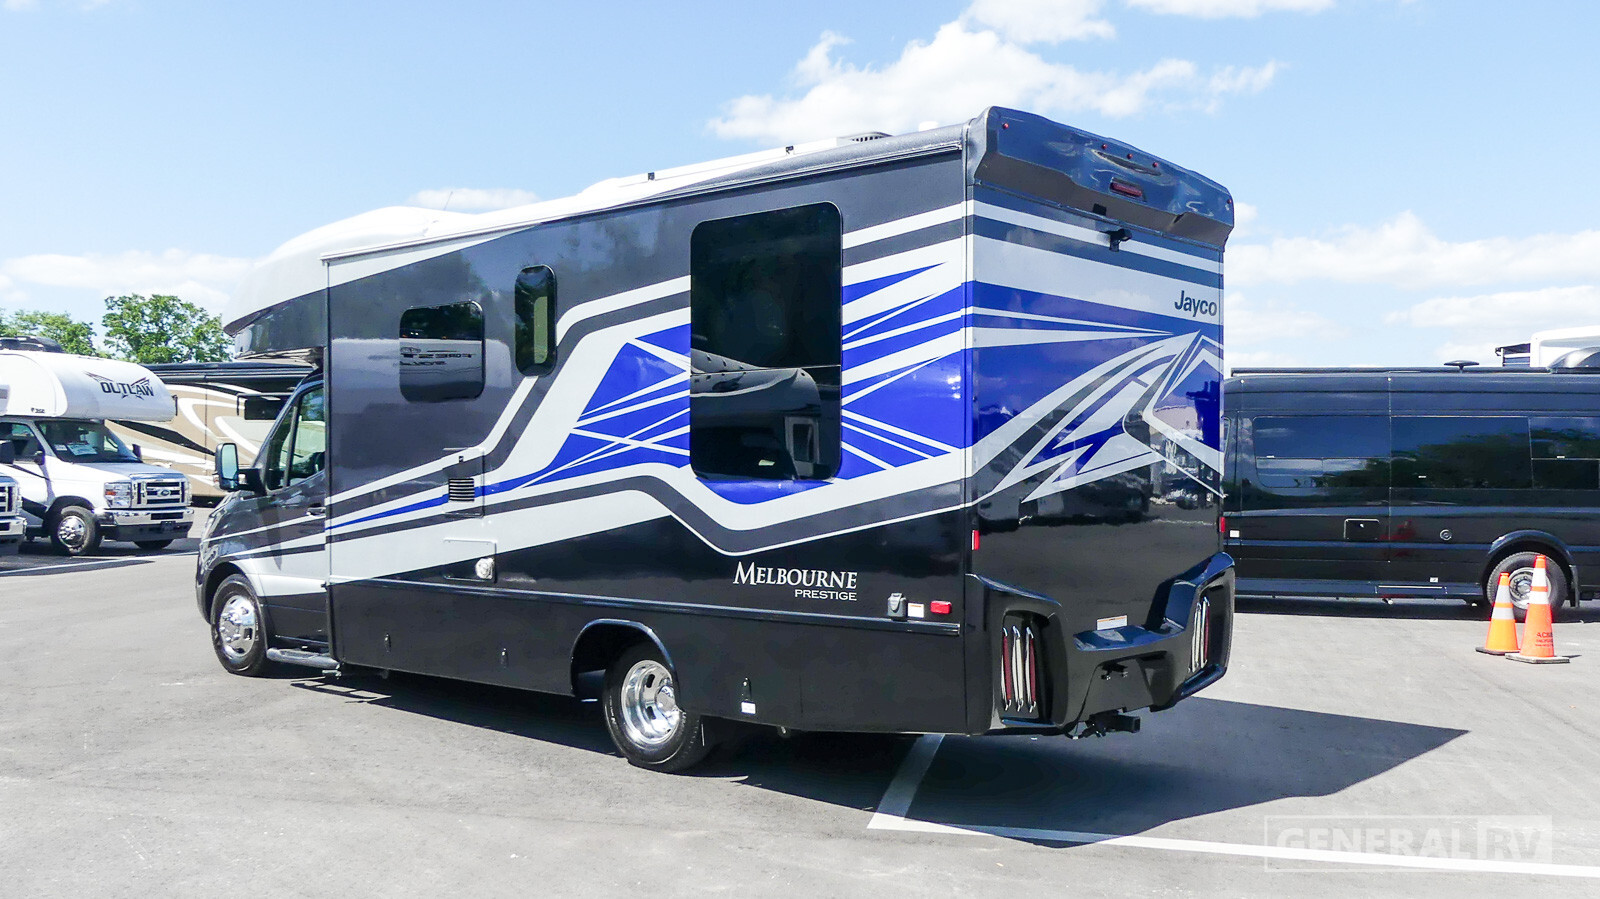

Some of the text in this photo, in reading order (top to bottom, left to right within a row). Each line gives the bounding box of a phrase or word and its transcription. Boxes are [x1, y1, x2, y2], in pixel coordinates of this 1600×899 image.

[1174, 290, 1218, 317] Jayco
[100, 380, 154, 397] OUTLAW
[733, 561, 858, 589] MELBOURNE
[795, 589, 858, 601] PRESTIGE
